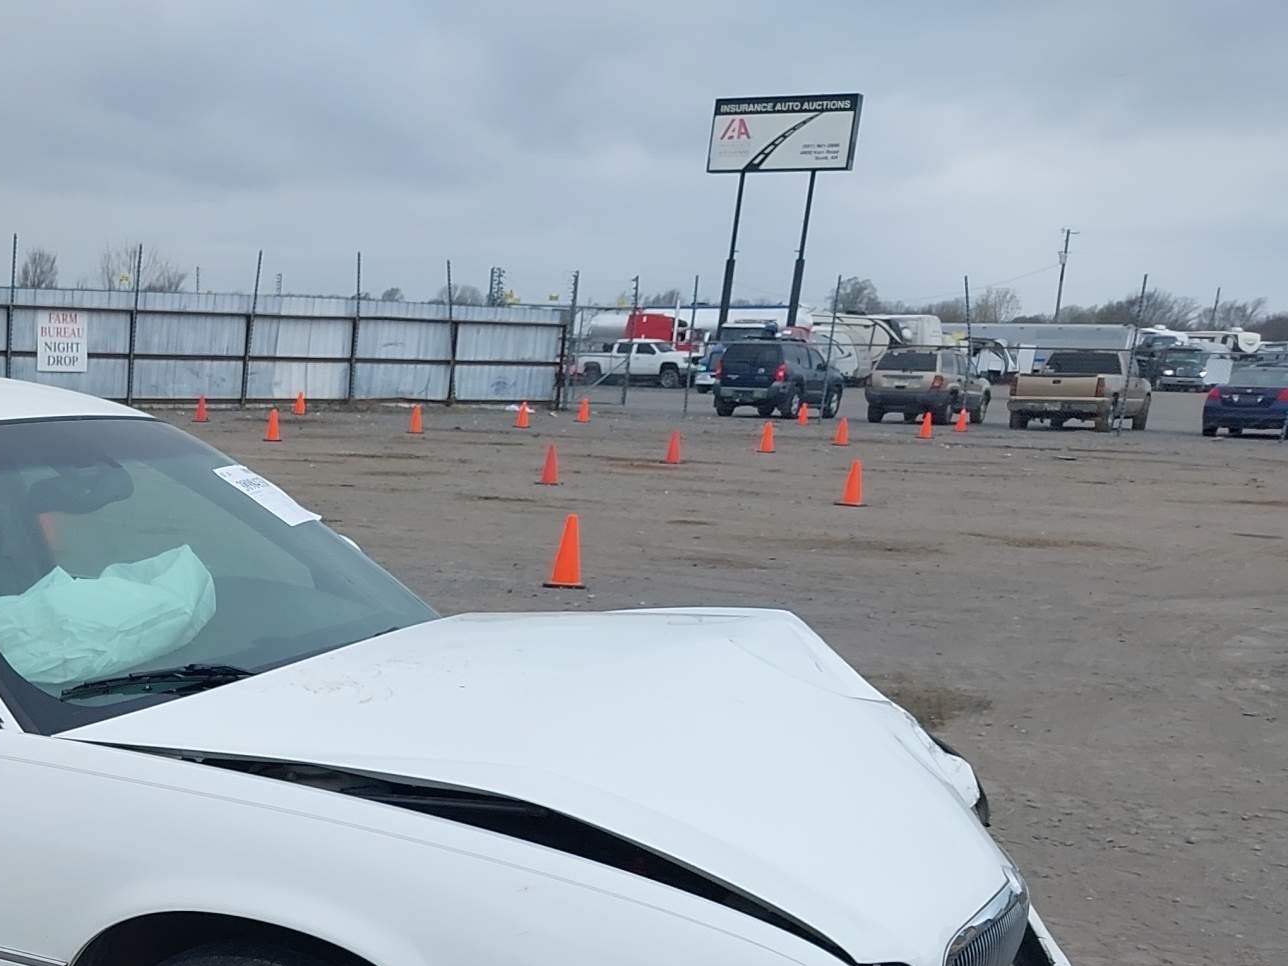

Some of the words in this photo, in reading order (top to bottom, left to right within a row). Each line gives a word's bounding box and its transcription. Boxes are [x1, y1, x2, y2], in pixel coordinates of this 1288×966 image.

[720, 102, 774, 113] INSURANCE
[775, 101, 801, 111] AUTO
[802, 99, 851, 110] AUCTIONS
[48, 311, 78, 324] FARM
[40, 326, 84, 338] BUREAU
[44, 341, 81, 353] NIGHT
[47, 355, 79, 367] DROP
